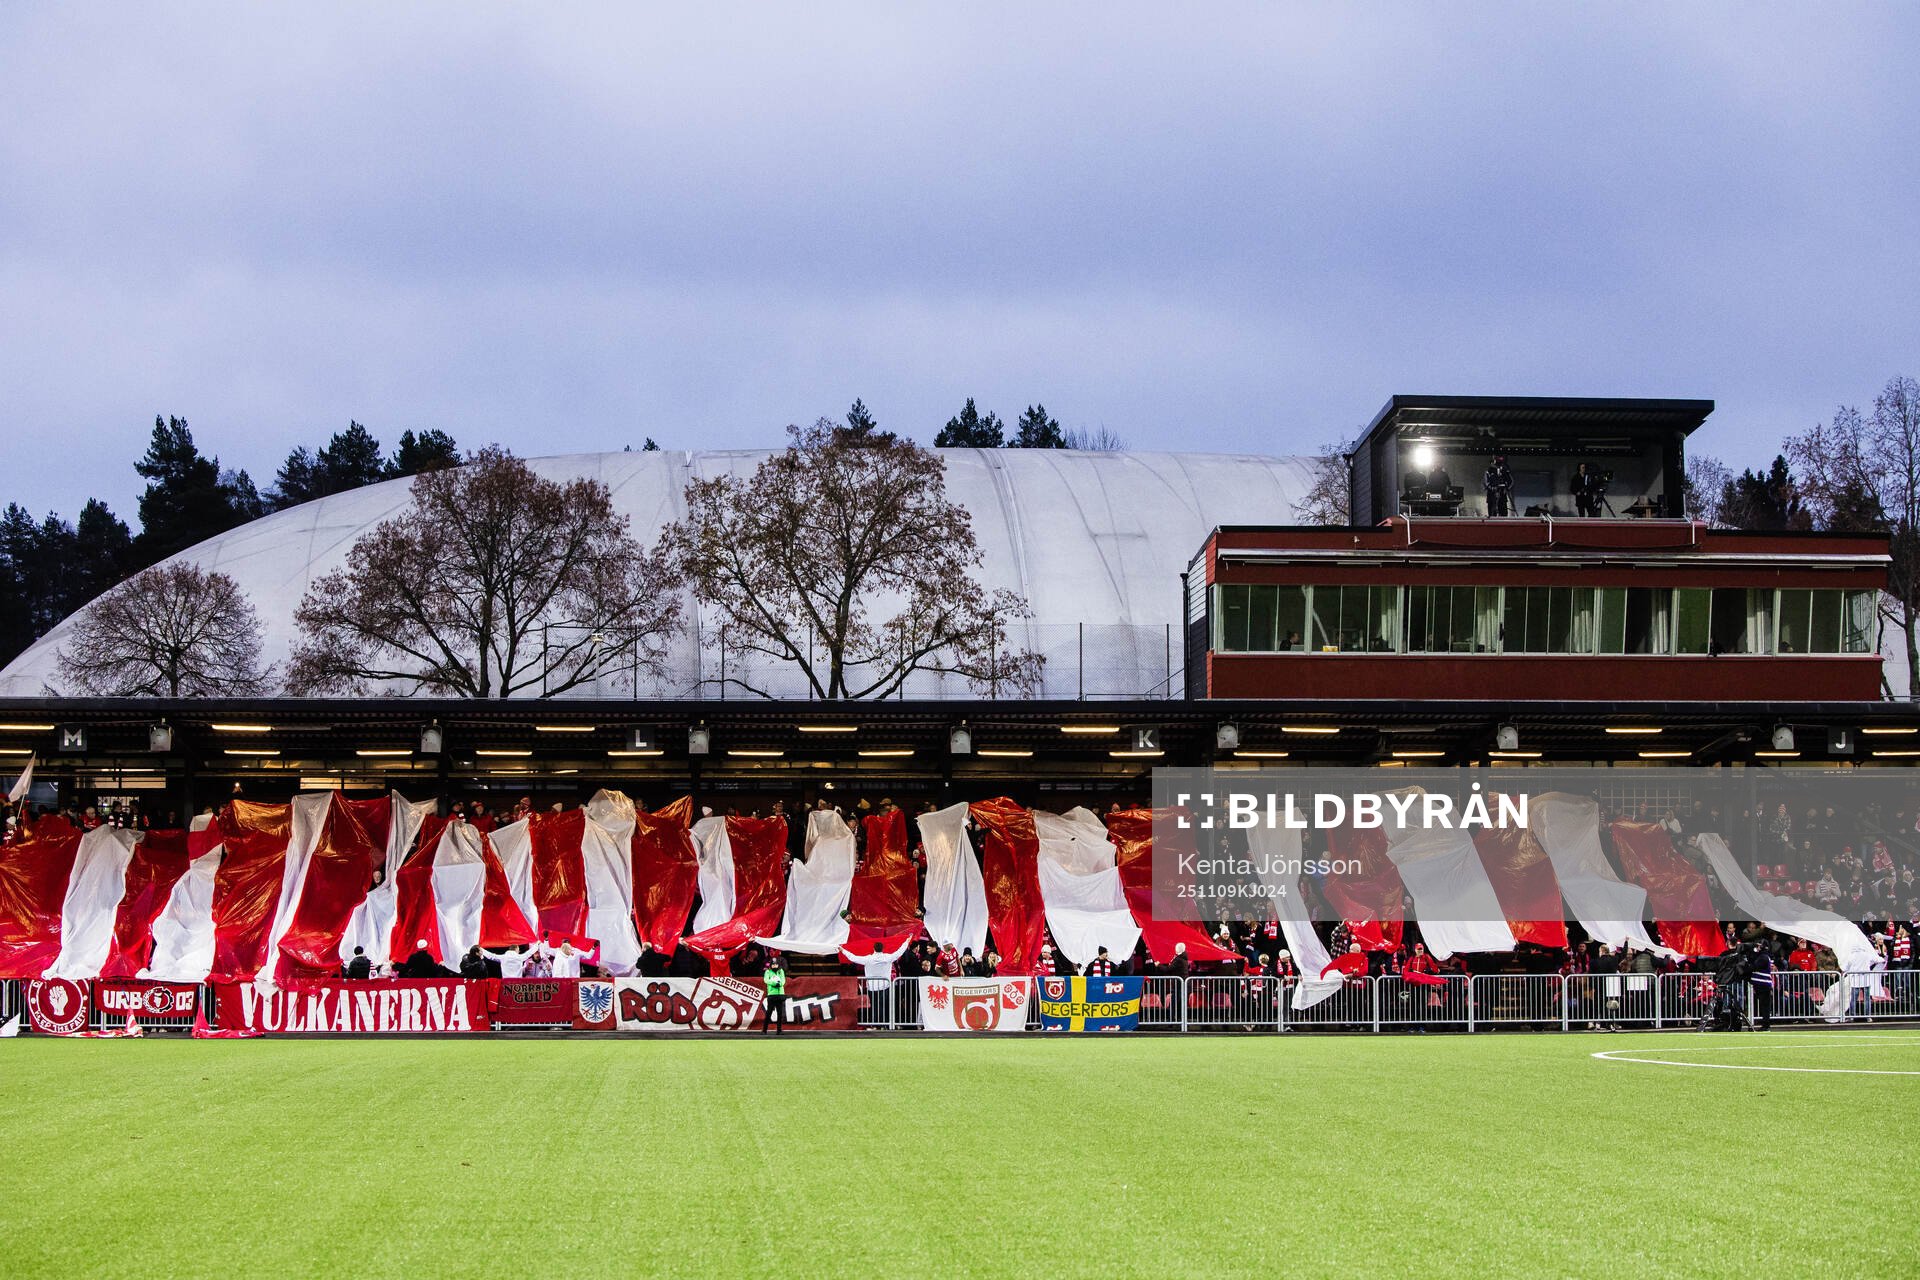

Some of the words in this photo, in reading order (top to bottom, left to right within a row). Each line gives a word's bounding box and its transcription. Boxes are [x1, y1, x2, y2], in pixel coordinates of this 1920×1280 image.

[64, 729, 82, 746] M
[635, 729, 647, 747] L
[1139, 730, 1154, 748] K
[1835, 731, 1846, 748] J
[955, 987, 997, 995] DEGERFORS
[103, 990, 142, 1009] URB
[175, 992, 194, 1011] 03
[240, 982, 472, 1032] VULKANERNA
[618, 982, 698, 1024] RÖD
[1041, 1001, 1129, 1017] DEGERFORS
